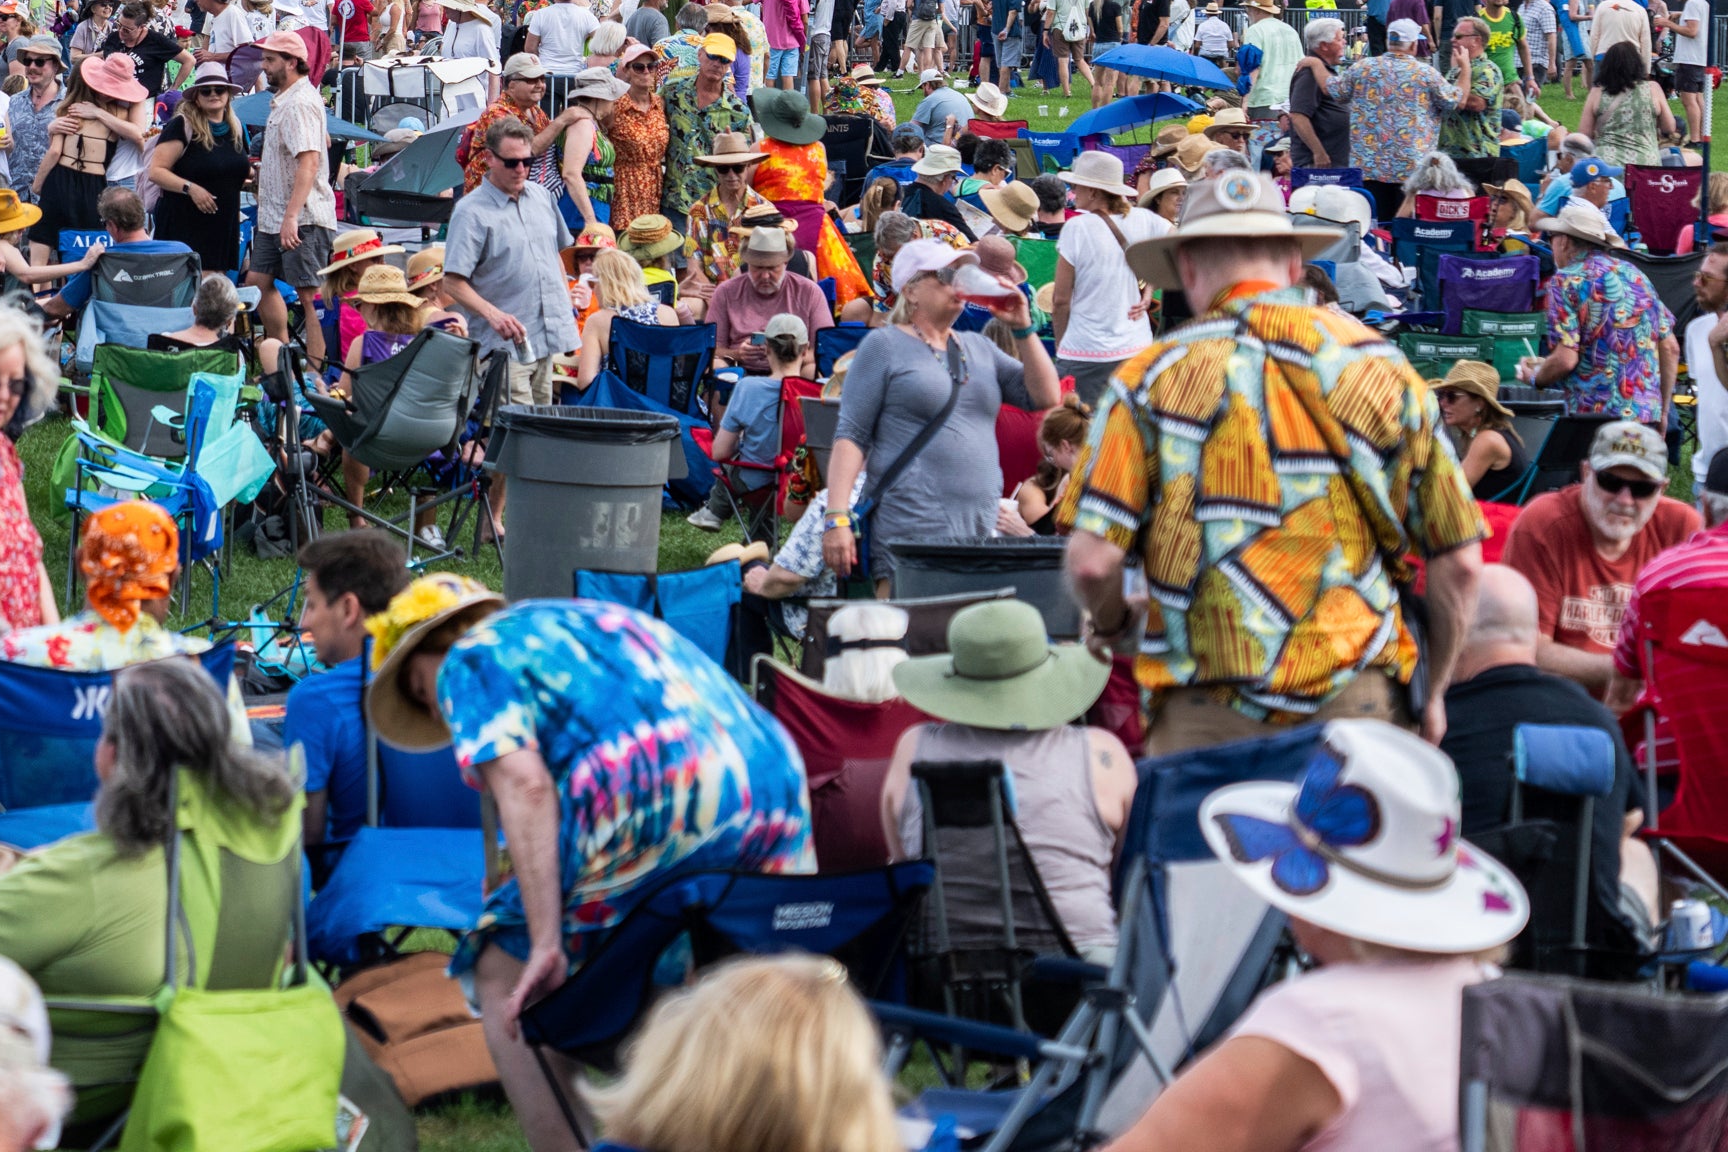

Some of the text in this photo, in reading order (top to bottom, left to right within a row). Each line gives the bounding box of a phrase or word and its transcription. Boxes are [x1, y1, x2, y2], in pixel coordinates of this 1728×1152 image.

[1414, 227, 1454, 238] Academy
[1475, 268, 1516, 280] Academy
[775, 902, 834, 917] MISSION
